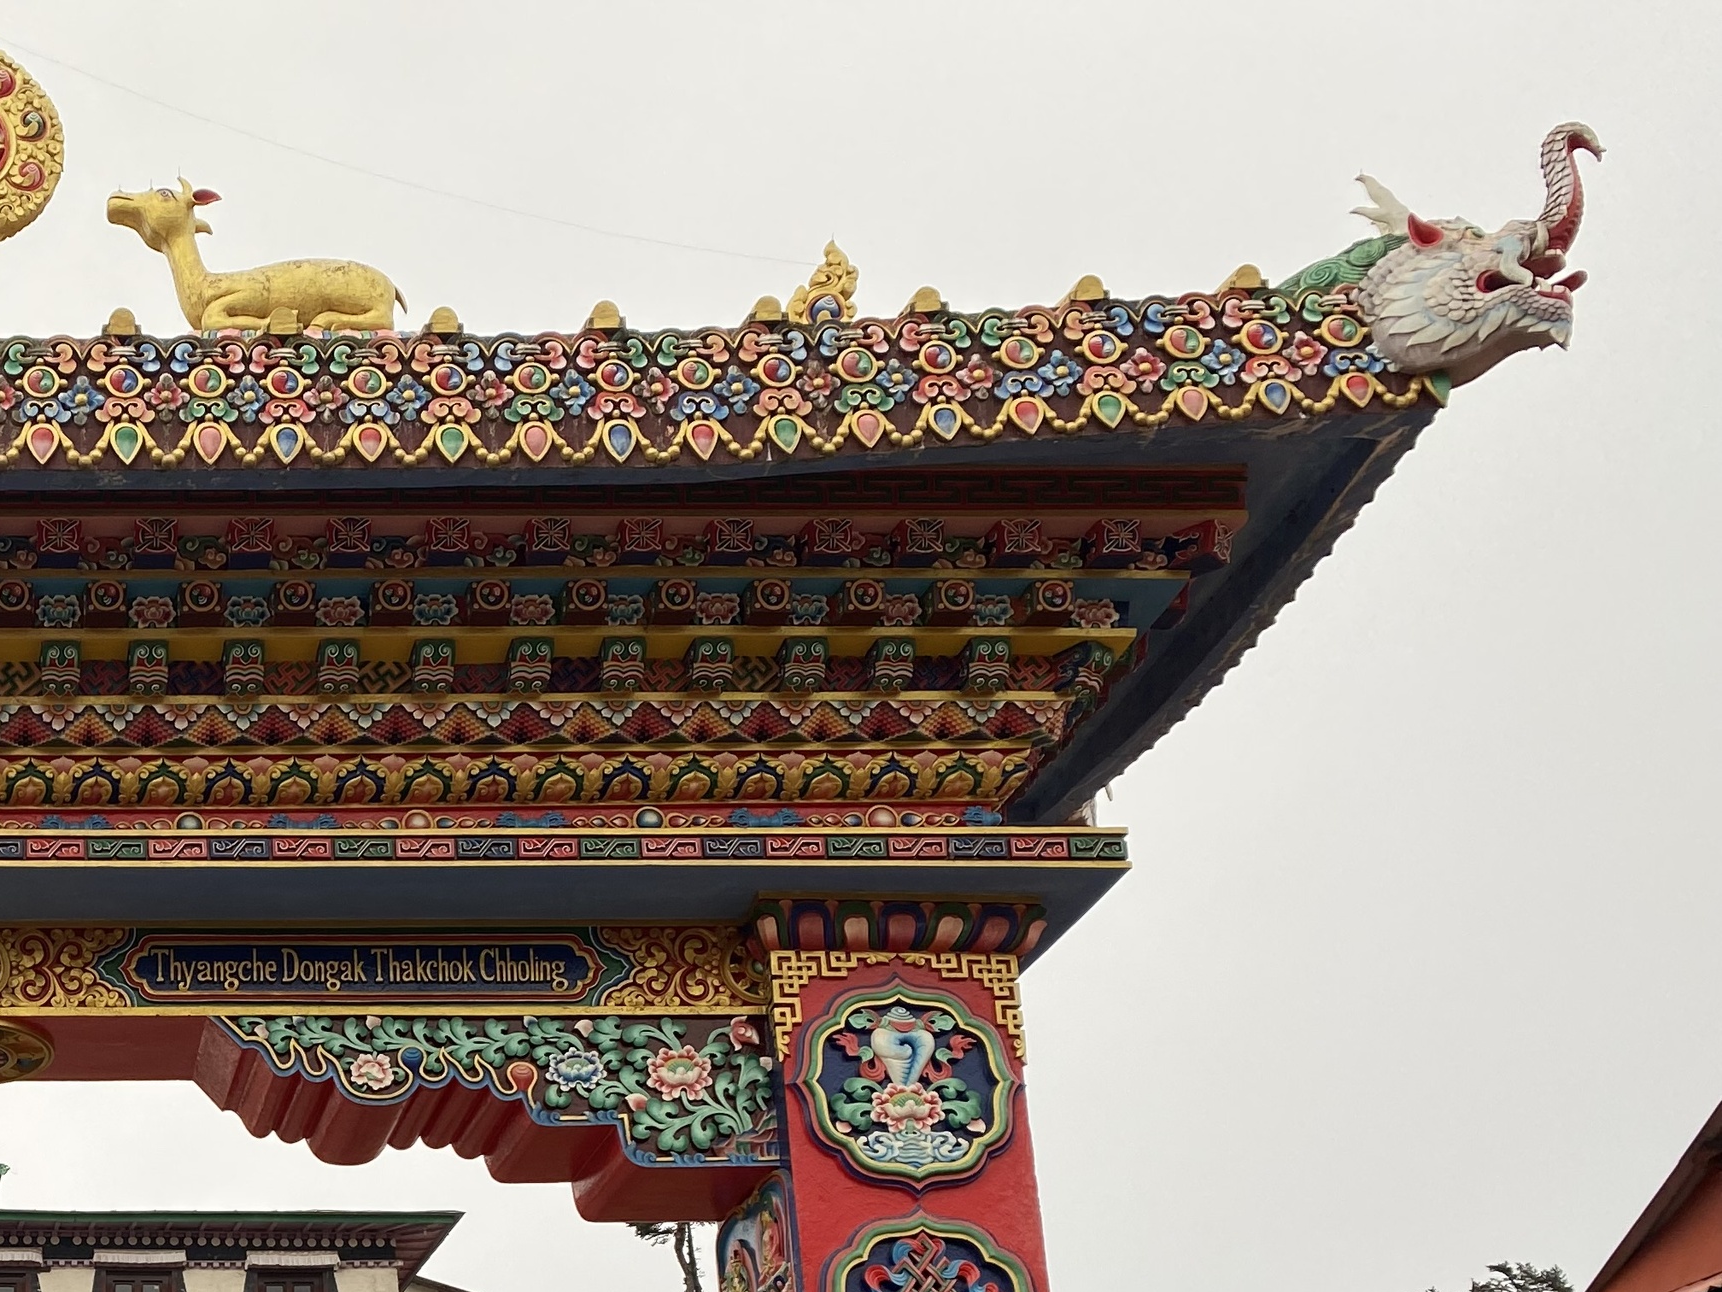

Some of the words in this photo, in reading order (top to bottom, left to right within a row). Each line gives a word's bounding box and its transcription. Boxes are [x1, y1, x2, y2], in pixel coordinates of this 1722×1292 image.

[150, 948, 277, 992] Thyangche
[281, 948, 368, 992] Dongak
[370, 948, 477, 983] Thakchok
[479, 948, 569, 992] Chholing
